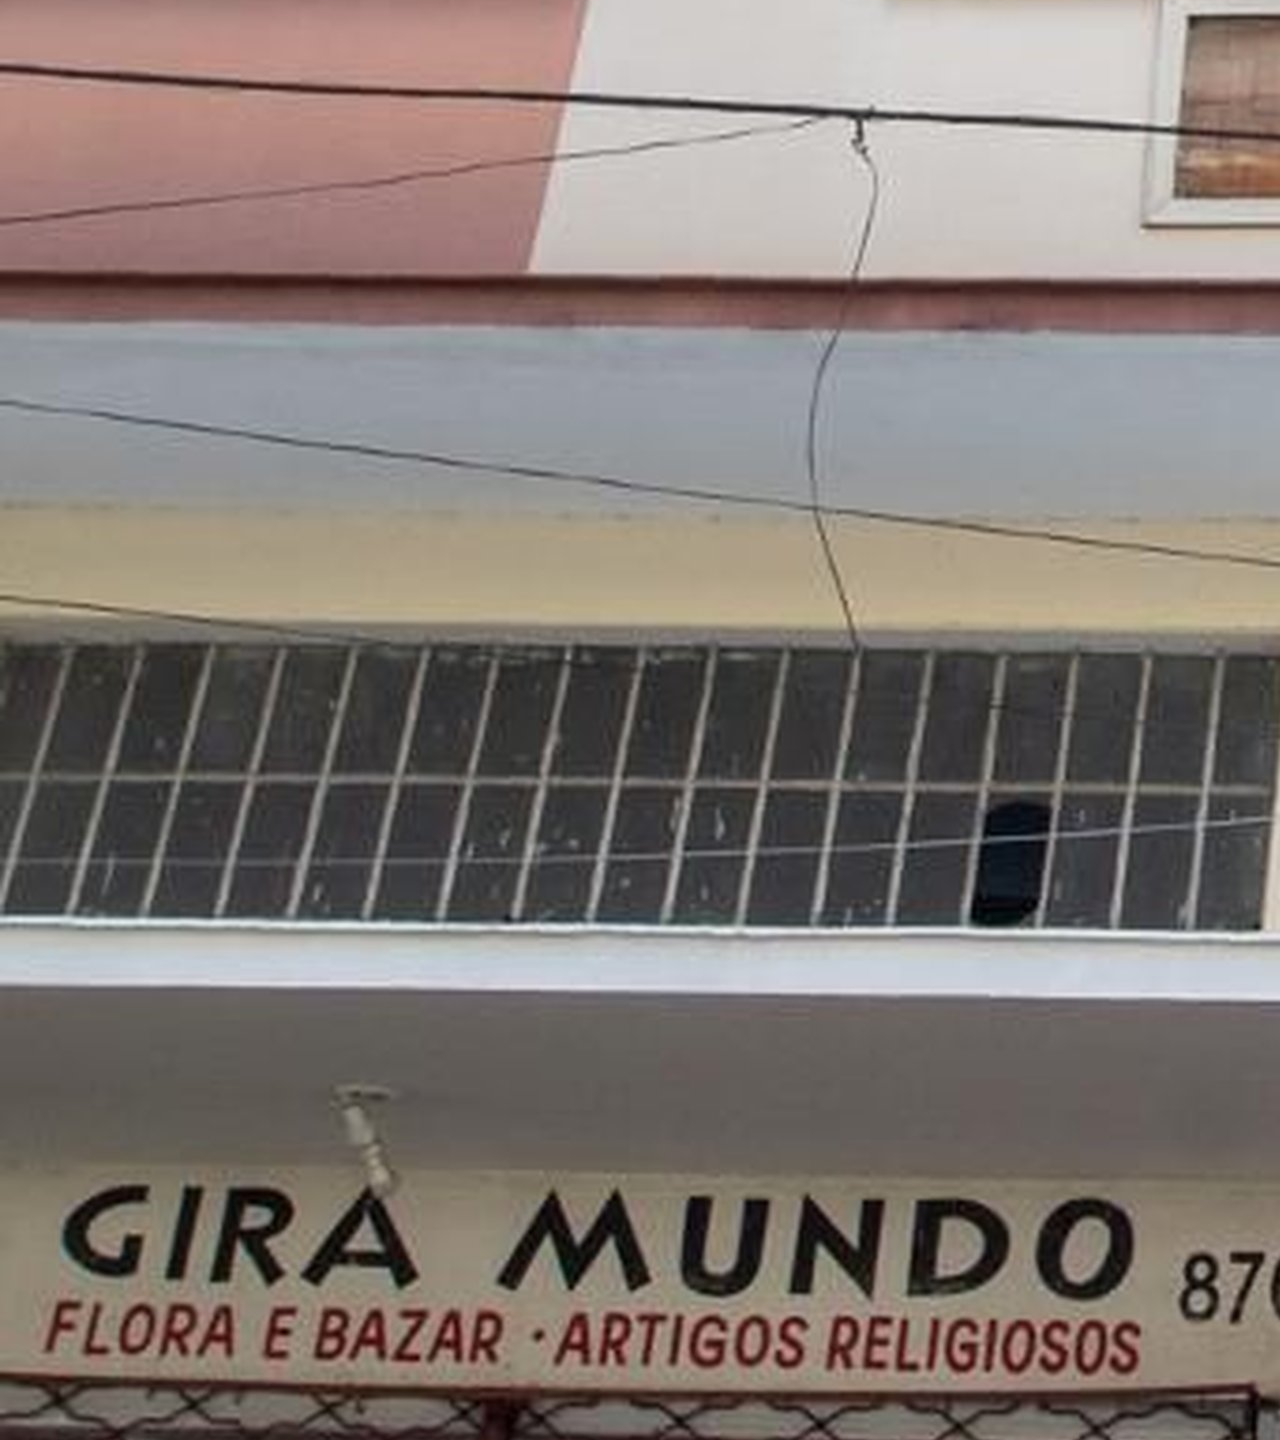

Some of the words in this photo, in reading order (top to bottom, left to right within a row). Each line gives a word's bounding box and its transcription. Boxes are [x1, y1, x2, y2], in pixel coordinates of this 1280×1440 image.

[61, 1185, 418, 1289] GIRA
[496, 1189, 1134, 1300] MUNDO
[44, 1300, 234, 1360] FLORA
[262, 1305, 297, 1361] E
[314, 1308, 503, 1366] BAZAR
[554, 1312, 807, 1370] ARTIGOS
[826, 1316, 1141, 1375] RELIGIOSOS
